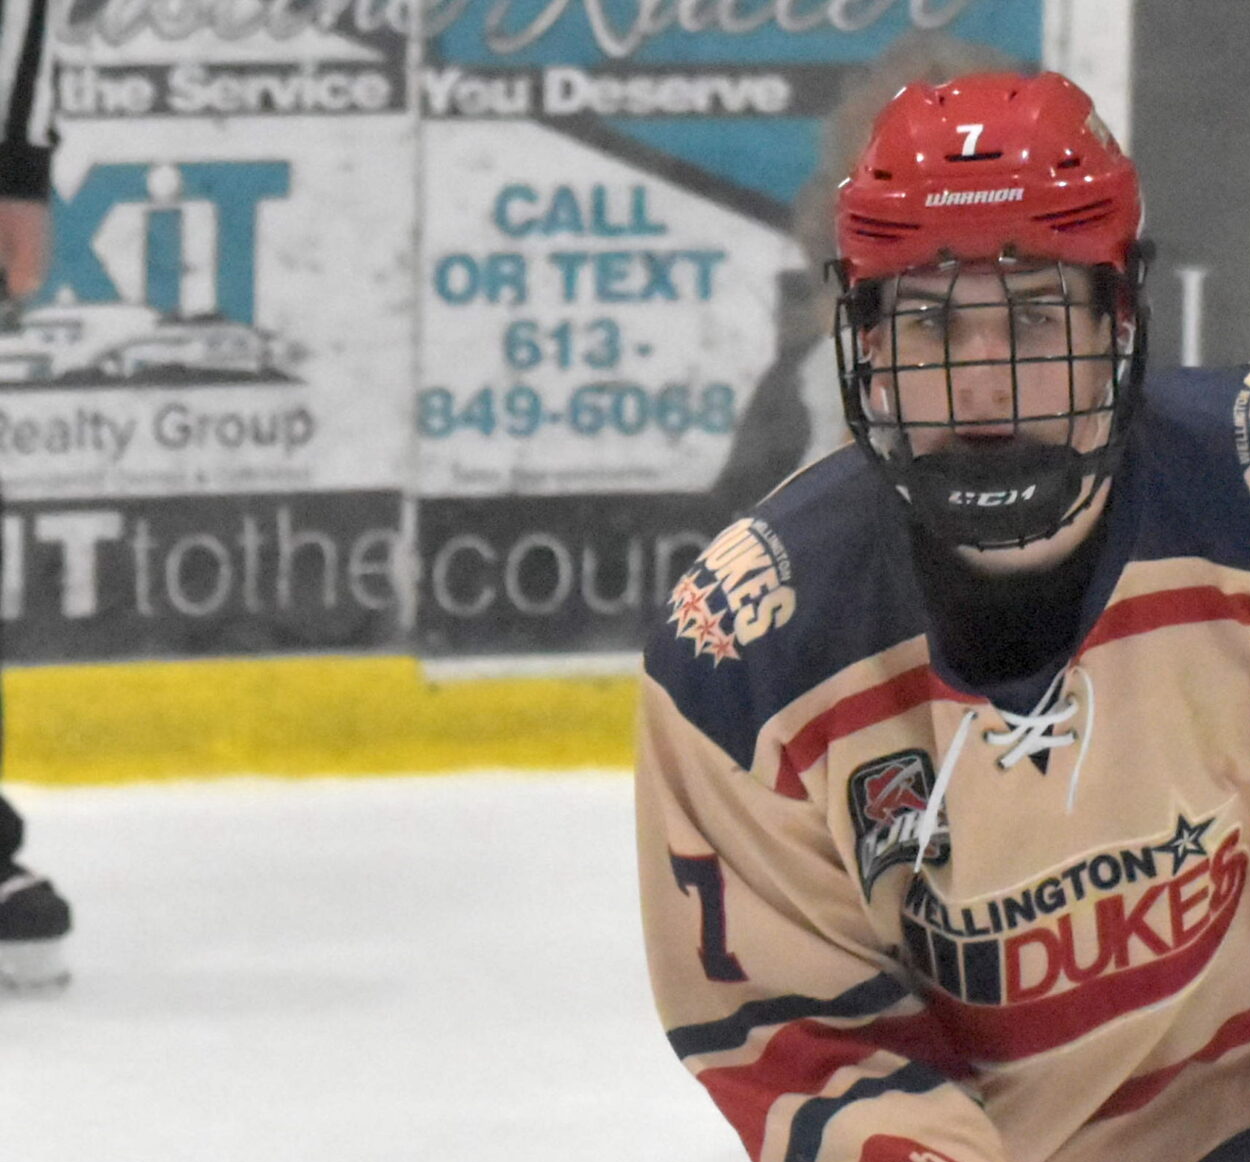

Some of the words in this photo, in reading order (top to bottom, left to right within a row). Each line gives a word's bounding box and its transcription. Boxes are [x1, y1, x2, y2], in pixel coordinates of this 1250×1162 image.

[58, 64, 152, 113] the
[166, 61, 391, 113] Service
[422, 68, 529, 114] You
[543, 67, 790, 116] Deserve
[955, 123, 984, 157] 7
[491, 183, 668, 239] CALL
[924, 187, 1025, 208] WARRIOR
[433, 252, 527, 305] OR
[547, 248, 727, 303] TEXT
[0, 405, 138, 465] ealty
[152, 401, 317, 457] Group
[417, 384, 736, 438] 849-6068
[669, 853, 749, 983] 7
[1003, 827, 1249, 1003] DUKES
